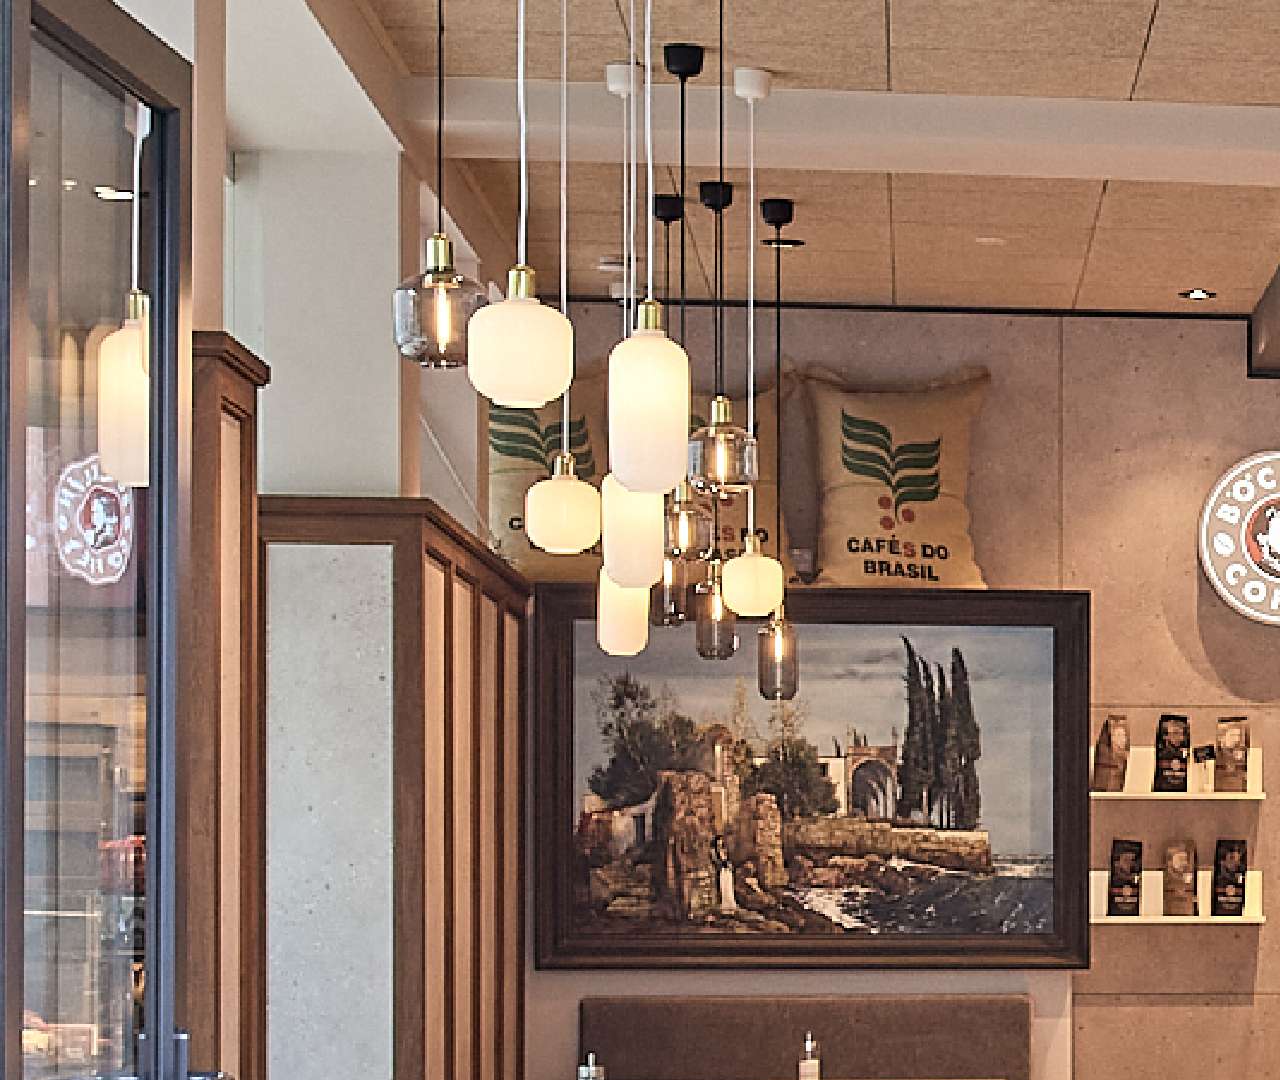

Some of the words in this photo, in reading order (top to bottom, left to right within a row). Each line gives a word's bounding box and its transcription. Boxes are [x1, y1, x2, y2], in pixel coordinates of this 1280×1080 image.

[846, 534, 917, 558] CAFÉS
[920, 542, 949, 560] DO
[863, 559, 940, 582] BRASIL
